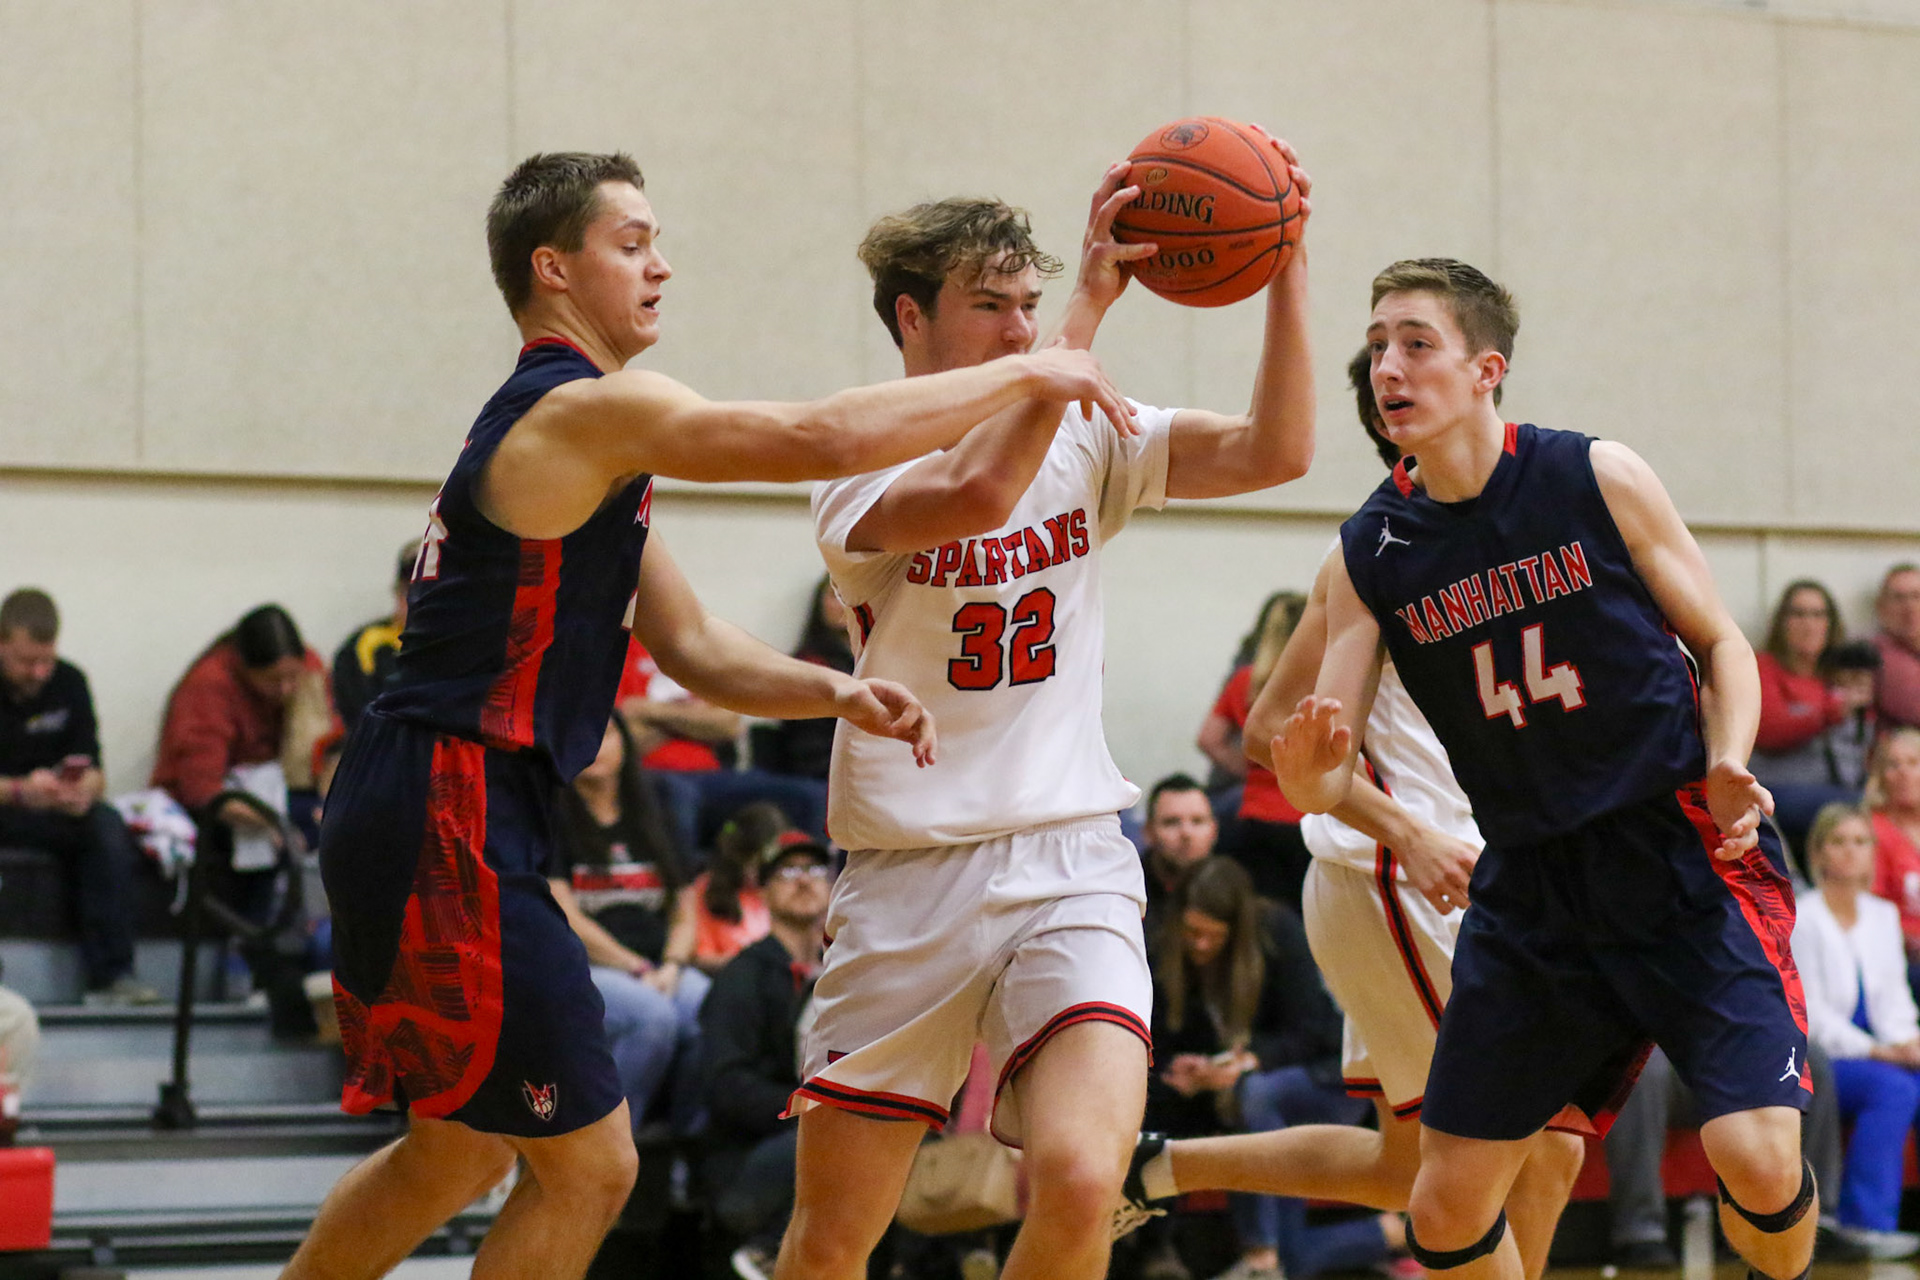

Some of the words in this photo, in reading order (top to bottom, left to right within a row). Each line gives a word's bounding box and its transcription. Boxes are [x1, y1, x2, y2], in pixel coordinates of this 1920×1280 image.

[906, 508, 1090, 588] SPARTANS
[1395, 541, 1593, 644] MANHATTAN
[948, 586, 1056, 691] 32
[1471, 622, 1588, 730] 44
